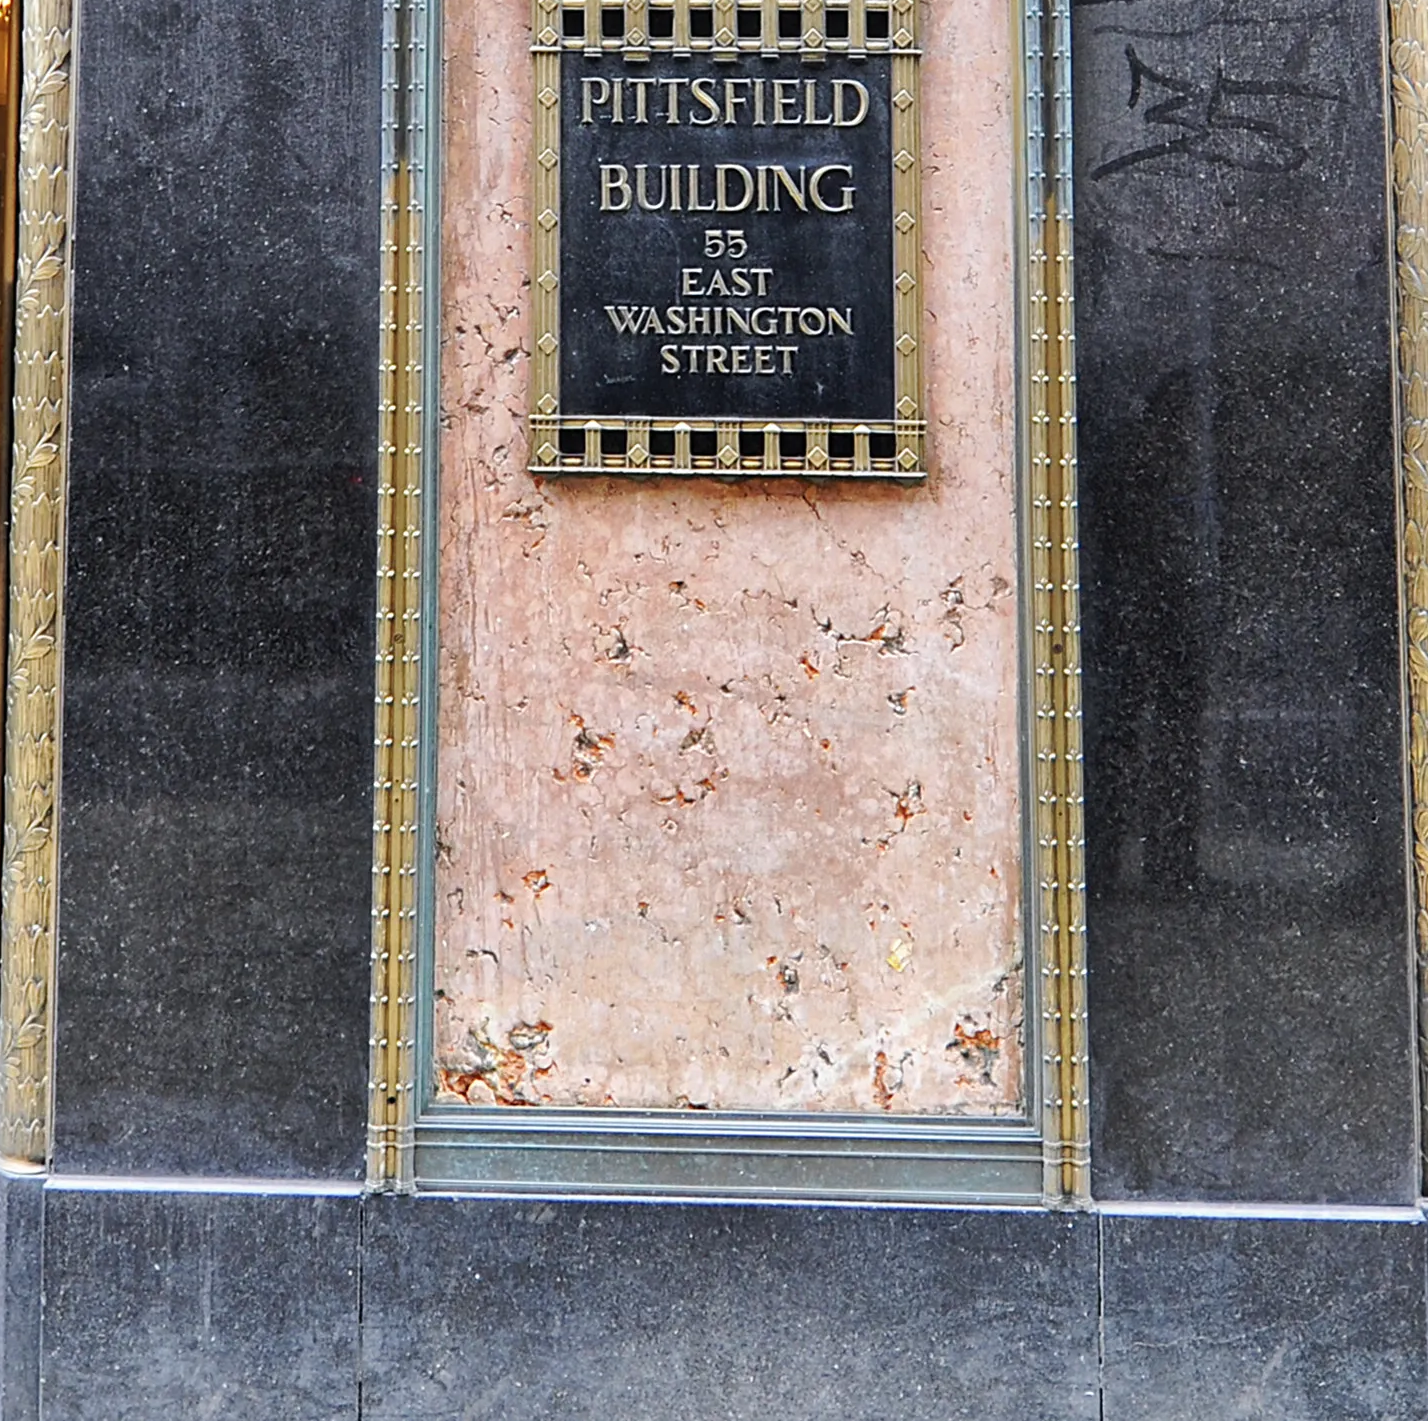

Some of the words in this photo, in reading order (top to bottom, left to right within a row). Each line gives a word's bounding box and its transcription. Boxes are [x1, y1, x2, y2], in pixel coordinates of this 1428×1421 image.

[580, 77, 870, 127] PITTSFIELD
[599, 164, 857, 212] BUILDING
[703, 229, 748, 258] 55
[681, 268, 774, 297] EAST
[603, 306, 855, 336] WASHINGTON
[659, 344, 800, 375] STREET
